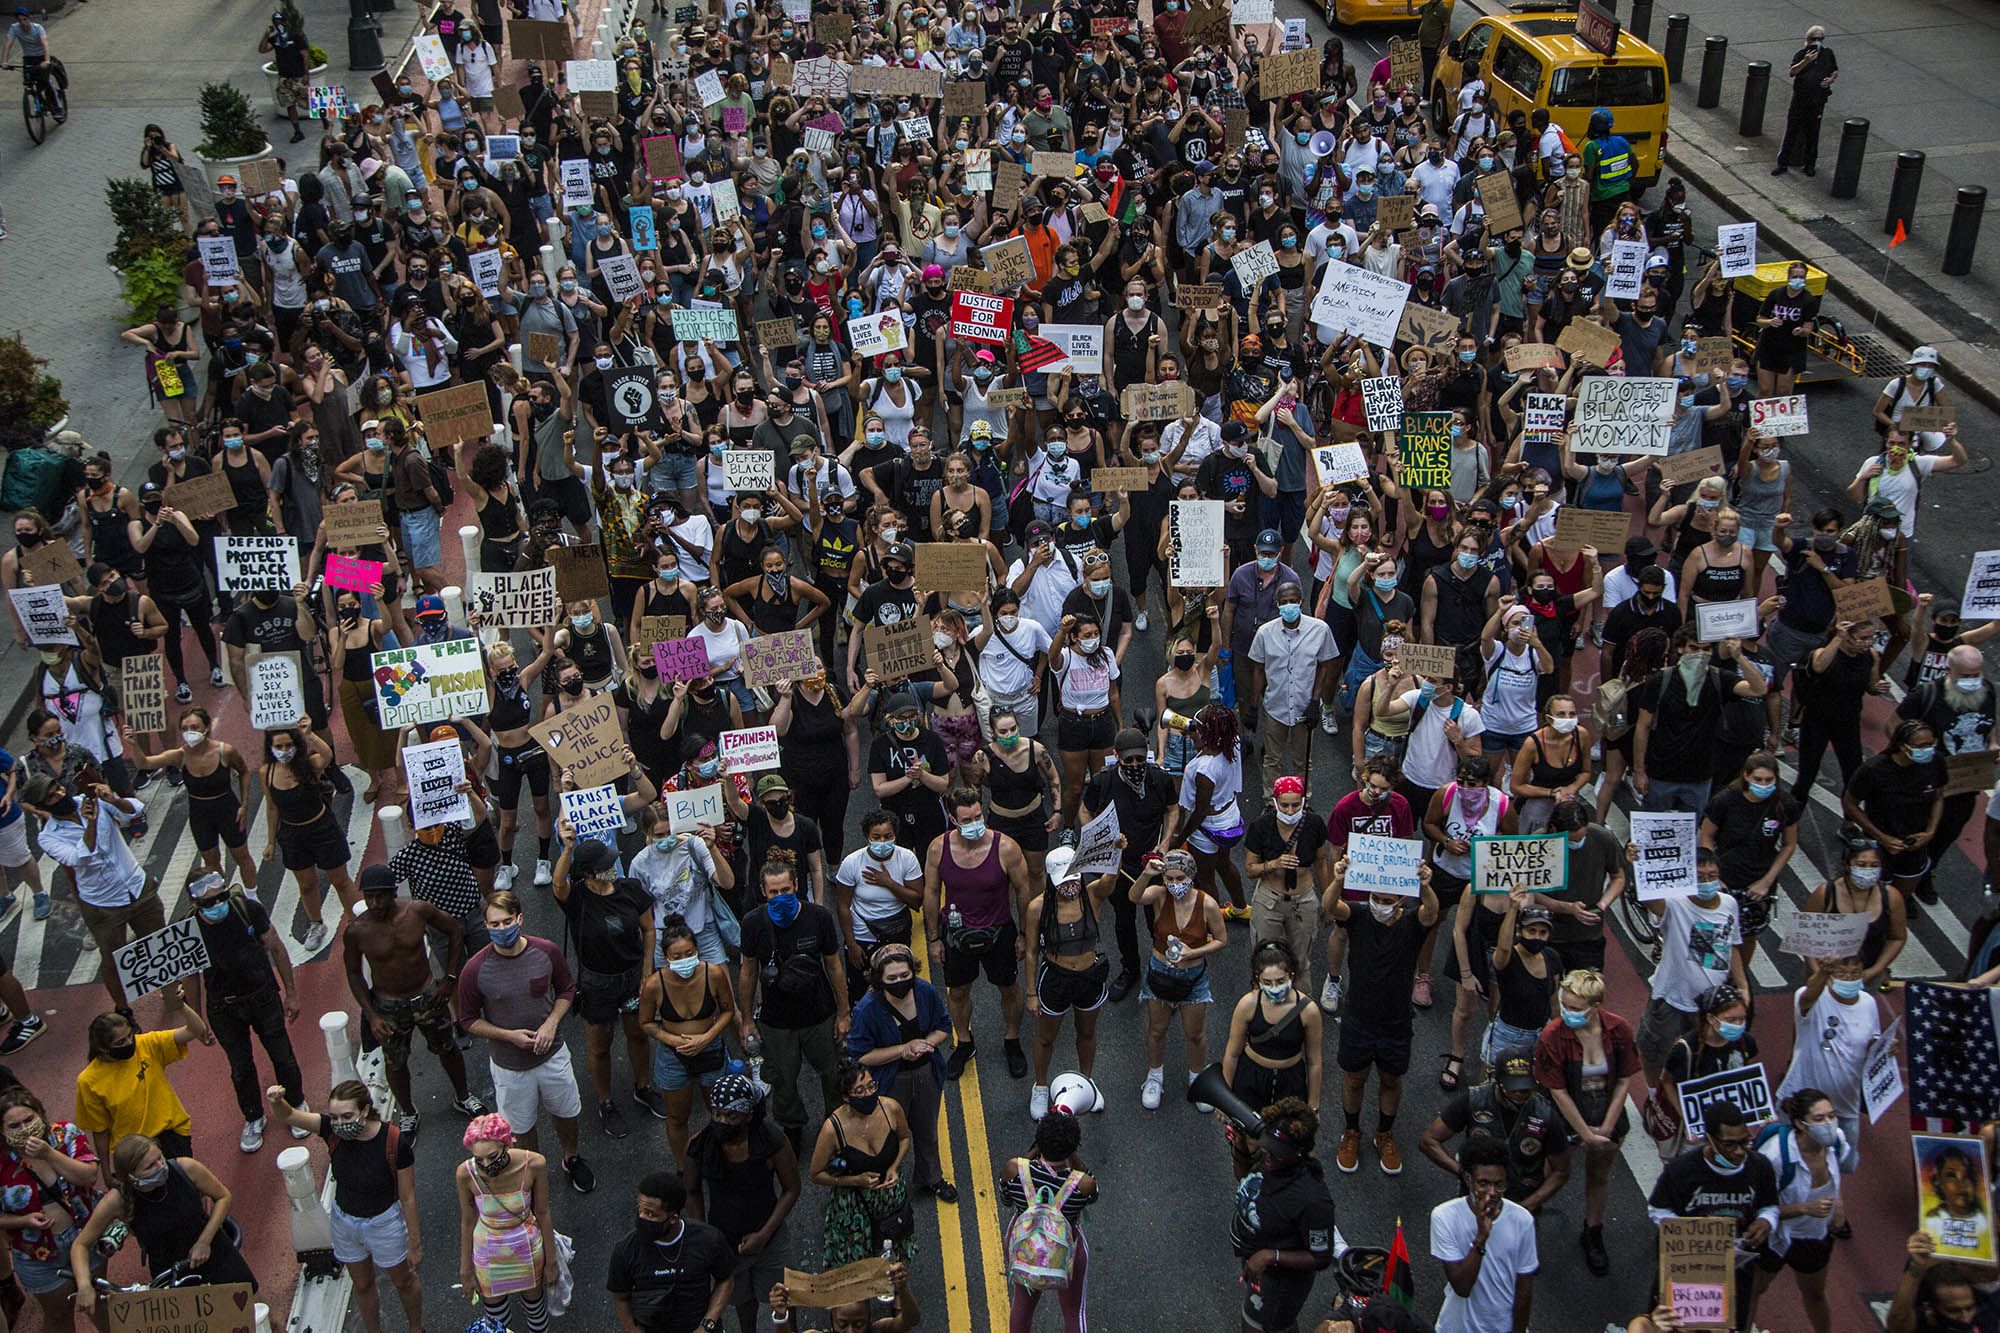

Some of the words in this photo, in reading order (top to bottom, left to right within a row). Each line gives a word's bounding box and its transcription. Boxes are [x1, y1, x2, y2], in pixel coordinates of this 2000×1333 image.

[1391, 42, 1419, 54] BLACK
[574, 62, 610, 71] BLACK
[1263, 55, 1284, 71] LAS
[1288, 48, 1317, 65] VIDAS
[1392, 53, 1421, 65] LIVES
[575, 71, 610, 80] LIVES
[698, 71, 716, 86] BLACK
[1265, 64, 1314, 82] NEGRAS
[576, 79, 612, 89] MATTER
[1263, 73, 1319, 98] IMPORTAN
[310, 96, 348, 109] BLACK
[995, 248, 1009, 259] NO
[1233, 246, 1264, 269] BLACK
[992, 255, 1026, 274] JUSTICE
[1250, 252, 1275, 272] LIVES
[953, 267, 977, 277] BLACK
[1005, 268, 1017, 278] NO
[1242, 261, 1278, 285] MATTER
[953, 276, 976, 284] LIVES
[1001, 273, 1026, 288] PEACE
[1178, 287, 1191, 295] NO
[1331, 280, 1376, 299] AMERICA
[961, 294, 1003, 310] JUSTICE
[1177, 296, 1192, 306] NO
[673, 310, 724, 321] JUSTICE
[729, 310, 735, 320] 4
[972, 310, 994, 324] FOR
[674, 323, 714, 340] GEORGE
[763, 328, 790, 337] BLACK
[852, 324, 872, 333] BLACK
[854, 331, 872, 340] LIVES
[953, 323, 1006, 340] BREONNA
[765, 335, 794, 346] WOMEN
[855, 337, 882, 348] MATTER
[1072, 334, 1093, 342] BLACK
[612, 375, 630, 389] BLACK
[632, 374, 650, 386] LIVES
[1587, 380, 1674, 402] PROTECT
[1528, 396, 1565, 411] BLACK
[1583, 400, 1660, 422] BLACK
[1136, 407, 1148, 419] NO
[1150, 404, 1179, 418] PEACE
[625, 417, 648, 425] MATTER
[1405, 416, 1453, 435] BLACK
[1527, 413, 1563, 428] LIVES
[1403, 434, 1450, 452] TRANS
[1577, 423, 1667, 448] WOMXN
[726, 453, 773, 464] DEFEND
[1401, 451, 1449, 469] LIVES
[730, 463, 769, 474] BLACK
[727, 476, 773, 488] WOMXN
[1401, 467, 1452, 487] MATTER
[228, 537, 284, 548] DEFEND
[226, 550, 287, 564] PROTECT
[573, 545, 600, 559] HER
[239, 563, 289, 577] BLACK
[820, 558, 847, 569] adidas
[225, 577, 291, 591] WOMEN
[494, 571, 553, 595] BLACK
[502, 590, 553, 610] LIVES
[32, 613, 56, 623] LIVES
[478, 609, 554, 629] MATTER
[657, 618, 670, 628] NO
[254, 617, 292, 637] CBGB
[643, 628, 683, 639] JUSTICE
[884, 620, 917, 637] BLACK
[374, 649, 418, 667] END
[430, 639, 477, 658] THE
[659, 638, 703, 659] BLACK
[745, 633, 806, 658] BLACK
[877, 633, 924, 661] BIRTH
[1401, 643, 1429, 656] BLACK
[1431, 646, 1456, 660] LIVES
[125, 657, 161, 675] BLACK
[749, 646, 813, 671] WOMXN
[882, 653, 927, 674] MATTERS
[1405, 658, 1444, 674] MATTER
[258, 661, 288, 673] BLACK
[661, 662, 709, 683] MATTER
[751, 661, 816, 685] MATTER
[124, 673, 161, 692] TRANS
[258, 670, 290, 681] TRANS
[263, 681, 282, 691] SEX
[429, 669, 485, 698] PRISON
[125, 691, 162, 710] LIVES
[256, 690, 294, 702] WORKER
[259, 700, 292, 711] LIVES
[126, 711, 164, 733] MATTER
[254, 709, 298, 725] MATTER
[548, 704, 611, 747] DEFUND
[570, 732, 599, 754] THE
[723, 730, 776, 750] FEMINISM
[567, 738, 620, 772] POLICE
[424, 758, 445, 770] BLACK
[423, 778, 451, 791] LIVES
[423, 795, 458, 811] MATTER
[564, 786, 613, 808] TRUST
[569, 803, 619, 822] BLACK
[676, 796, 717, 820] BLM
[1652, 830, 1675, 839] BLACK
[1489, 840, 1549, 856] BLACK
[1647, 848, 1679, 858] LIVES
[1350, 850, 1379, 864] POLICE
[1495, 855, 1546, 870] LIVES
[1348, 870, 1376, 884] SMALL
[1486, 869, 1552, 888] MATTER
[1646, 868, 1687, 881] MATTER
[119, 938, 152, 971] GET
[157, 920, 193, 954] IN
[131, 935, 202, 980] GOOD
[126, 944, 208, 997] TROUBLE
[1666, 1240, 1685, 1253] NO
[1689, 1239, 1733, 1253] PEACE
[137, 1295, 180, 1323] THIS
[195, 1293, 214, 1318] IS
